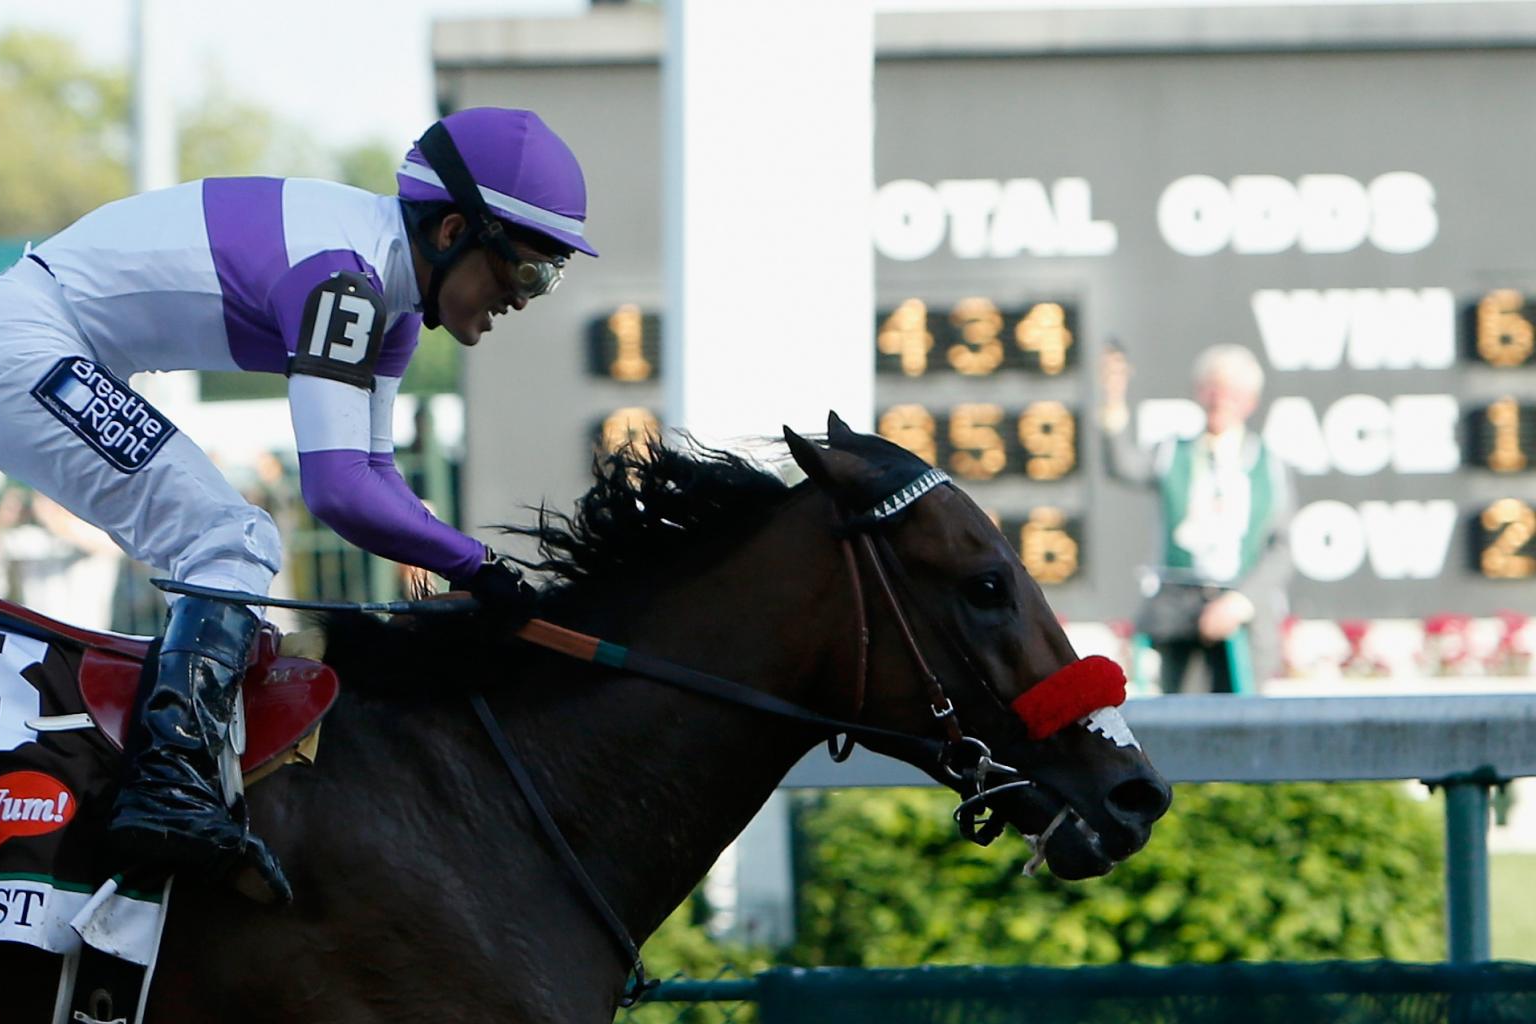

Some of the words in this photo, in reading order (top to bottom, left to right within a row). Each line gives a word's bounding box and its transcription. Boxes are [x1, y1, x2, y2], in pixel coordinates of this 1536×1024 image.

[872, 179, 1117, 261] OTAL
[1157, 171, 1439, 256] ODDS
[308, 291, 376, 364] 13
[878, 297, 1072, 377] 434
[1251, 287, 1456, 370] WIN
[71, 360, 162, 438] Breathe
[81, 398, 150, 462] Right
[1137, 394, 1460, 475] PACE
[1020, 506, 1079, 585] 6
[1289, 499, 1458, 581] OW
